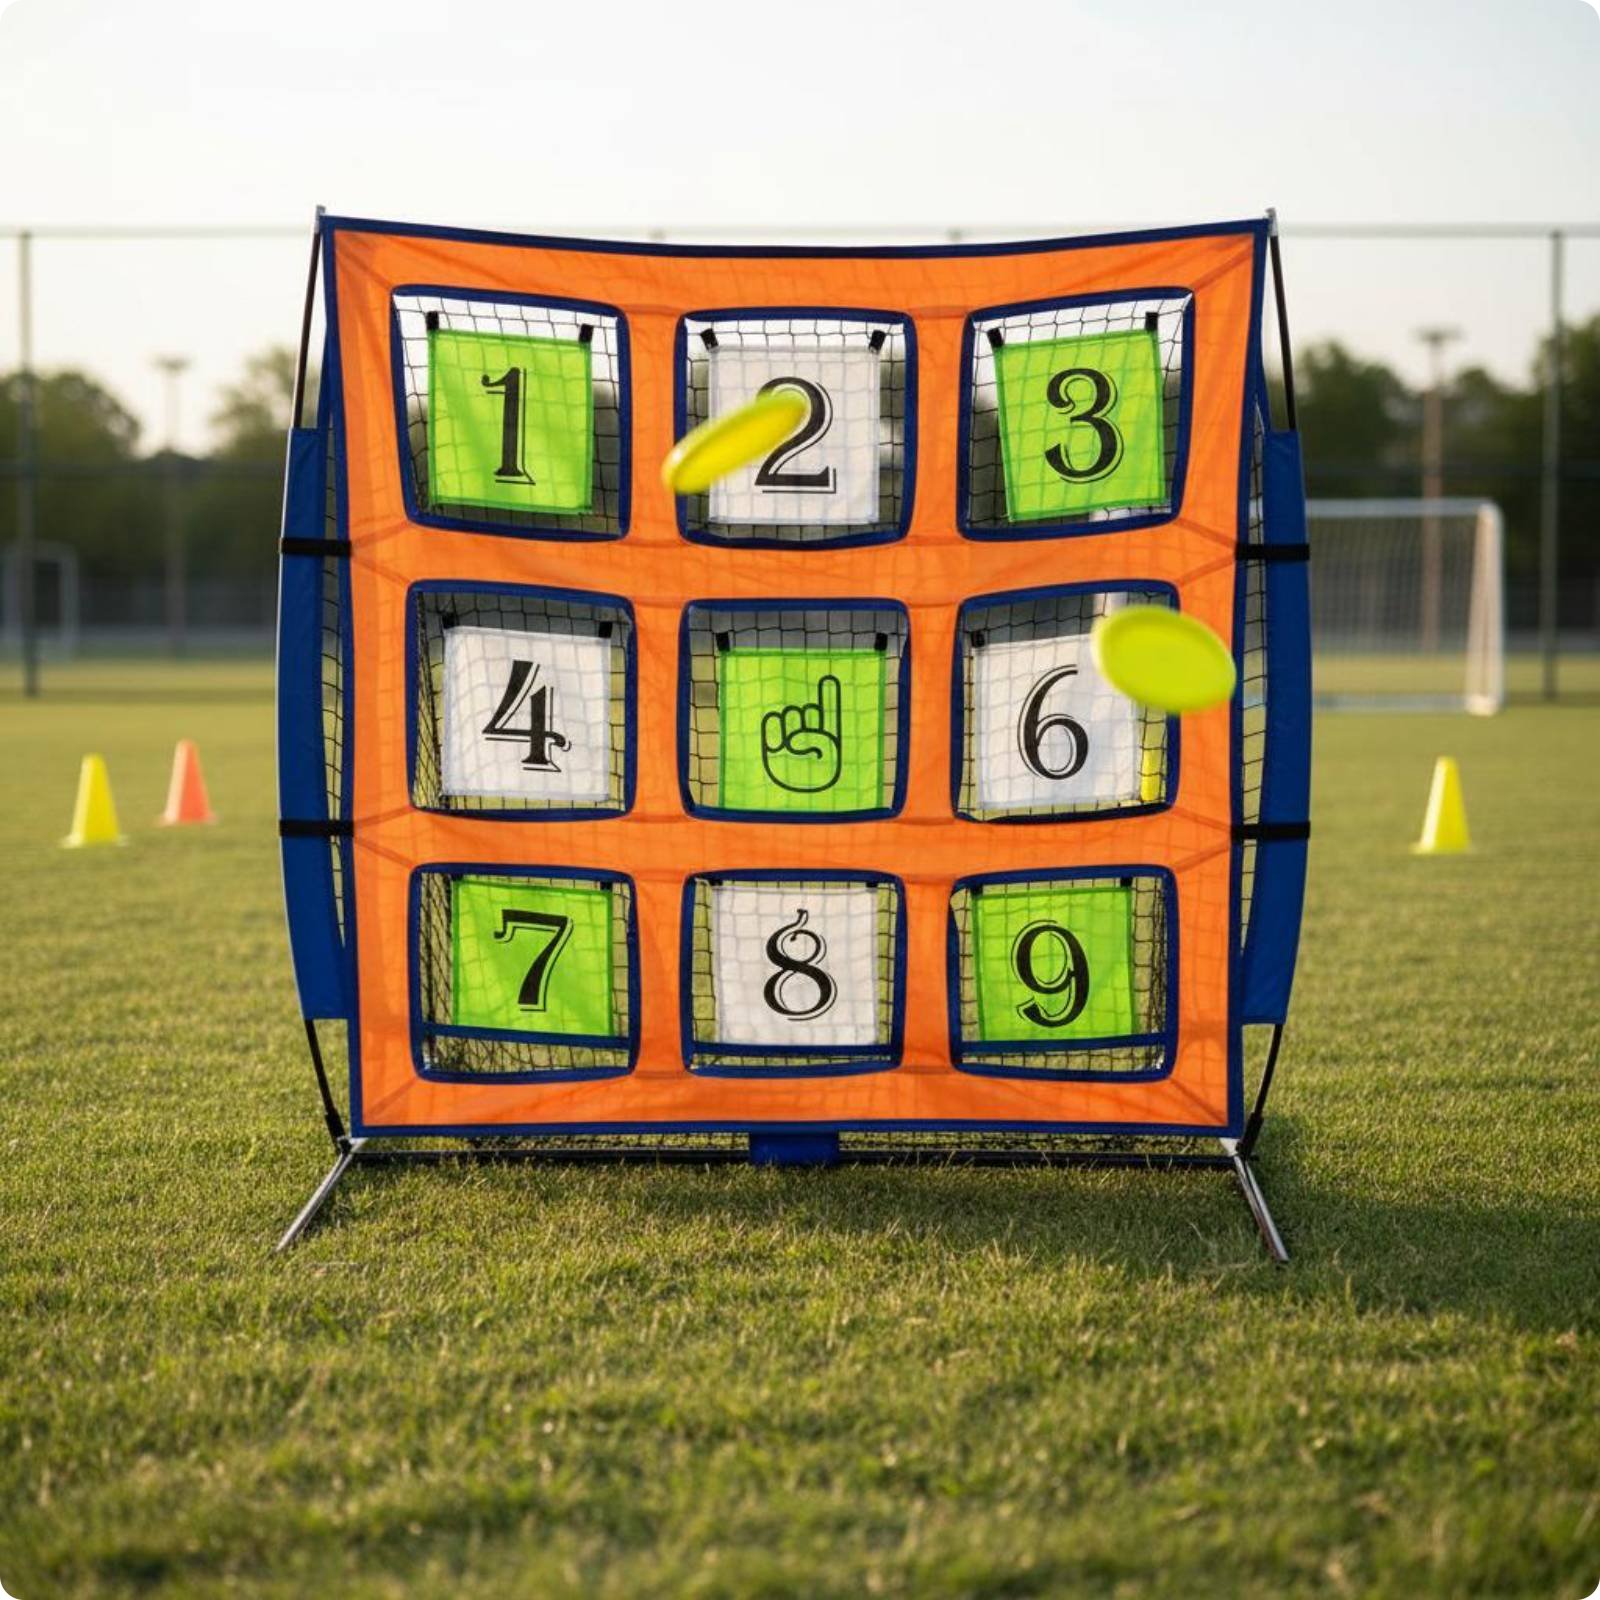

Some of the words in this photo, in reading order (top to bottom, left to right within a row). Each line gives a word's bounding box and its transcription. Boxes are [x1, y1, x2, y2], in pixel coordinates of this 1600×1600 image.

[481, 366, 536, 485] 1
[754, 375, 836, 494] 2
[1044, 367, 1123, 483] 3
[482, 659, 572, 773] 4
[1018, 664, 1089, 781] 6
[493, 909, 573, 1012] 7
[763, 907, 838, 1021] 8
[1010, 919, 1091, 1028] 9
